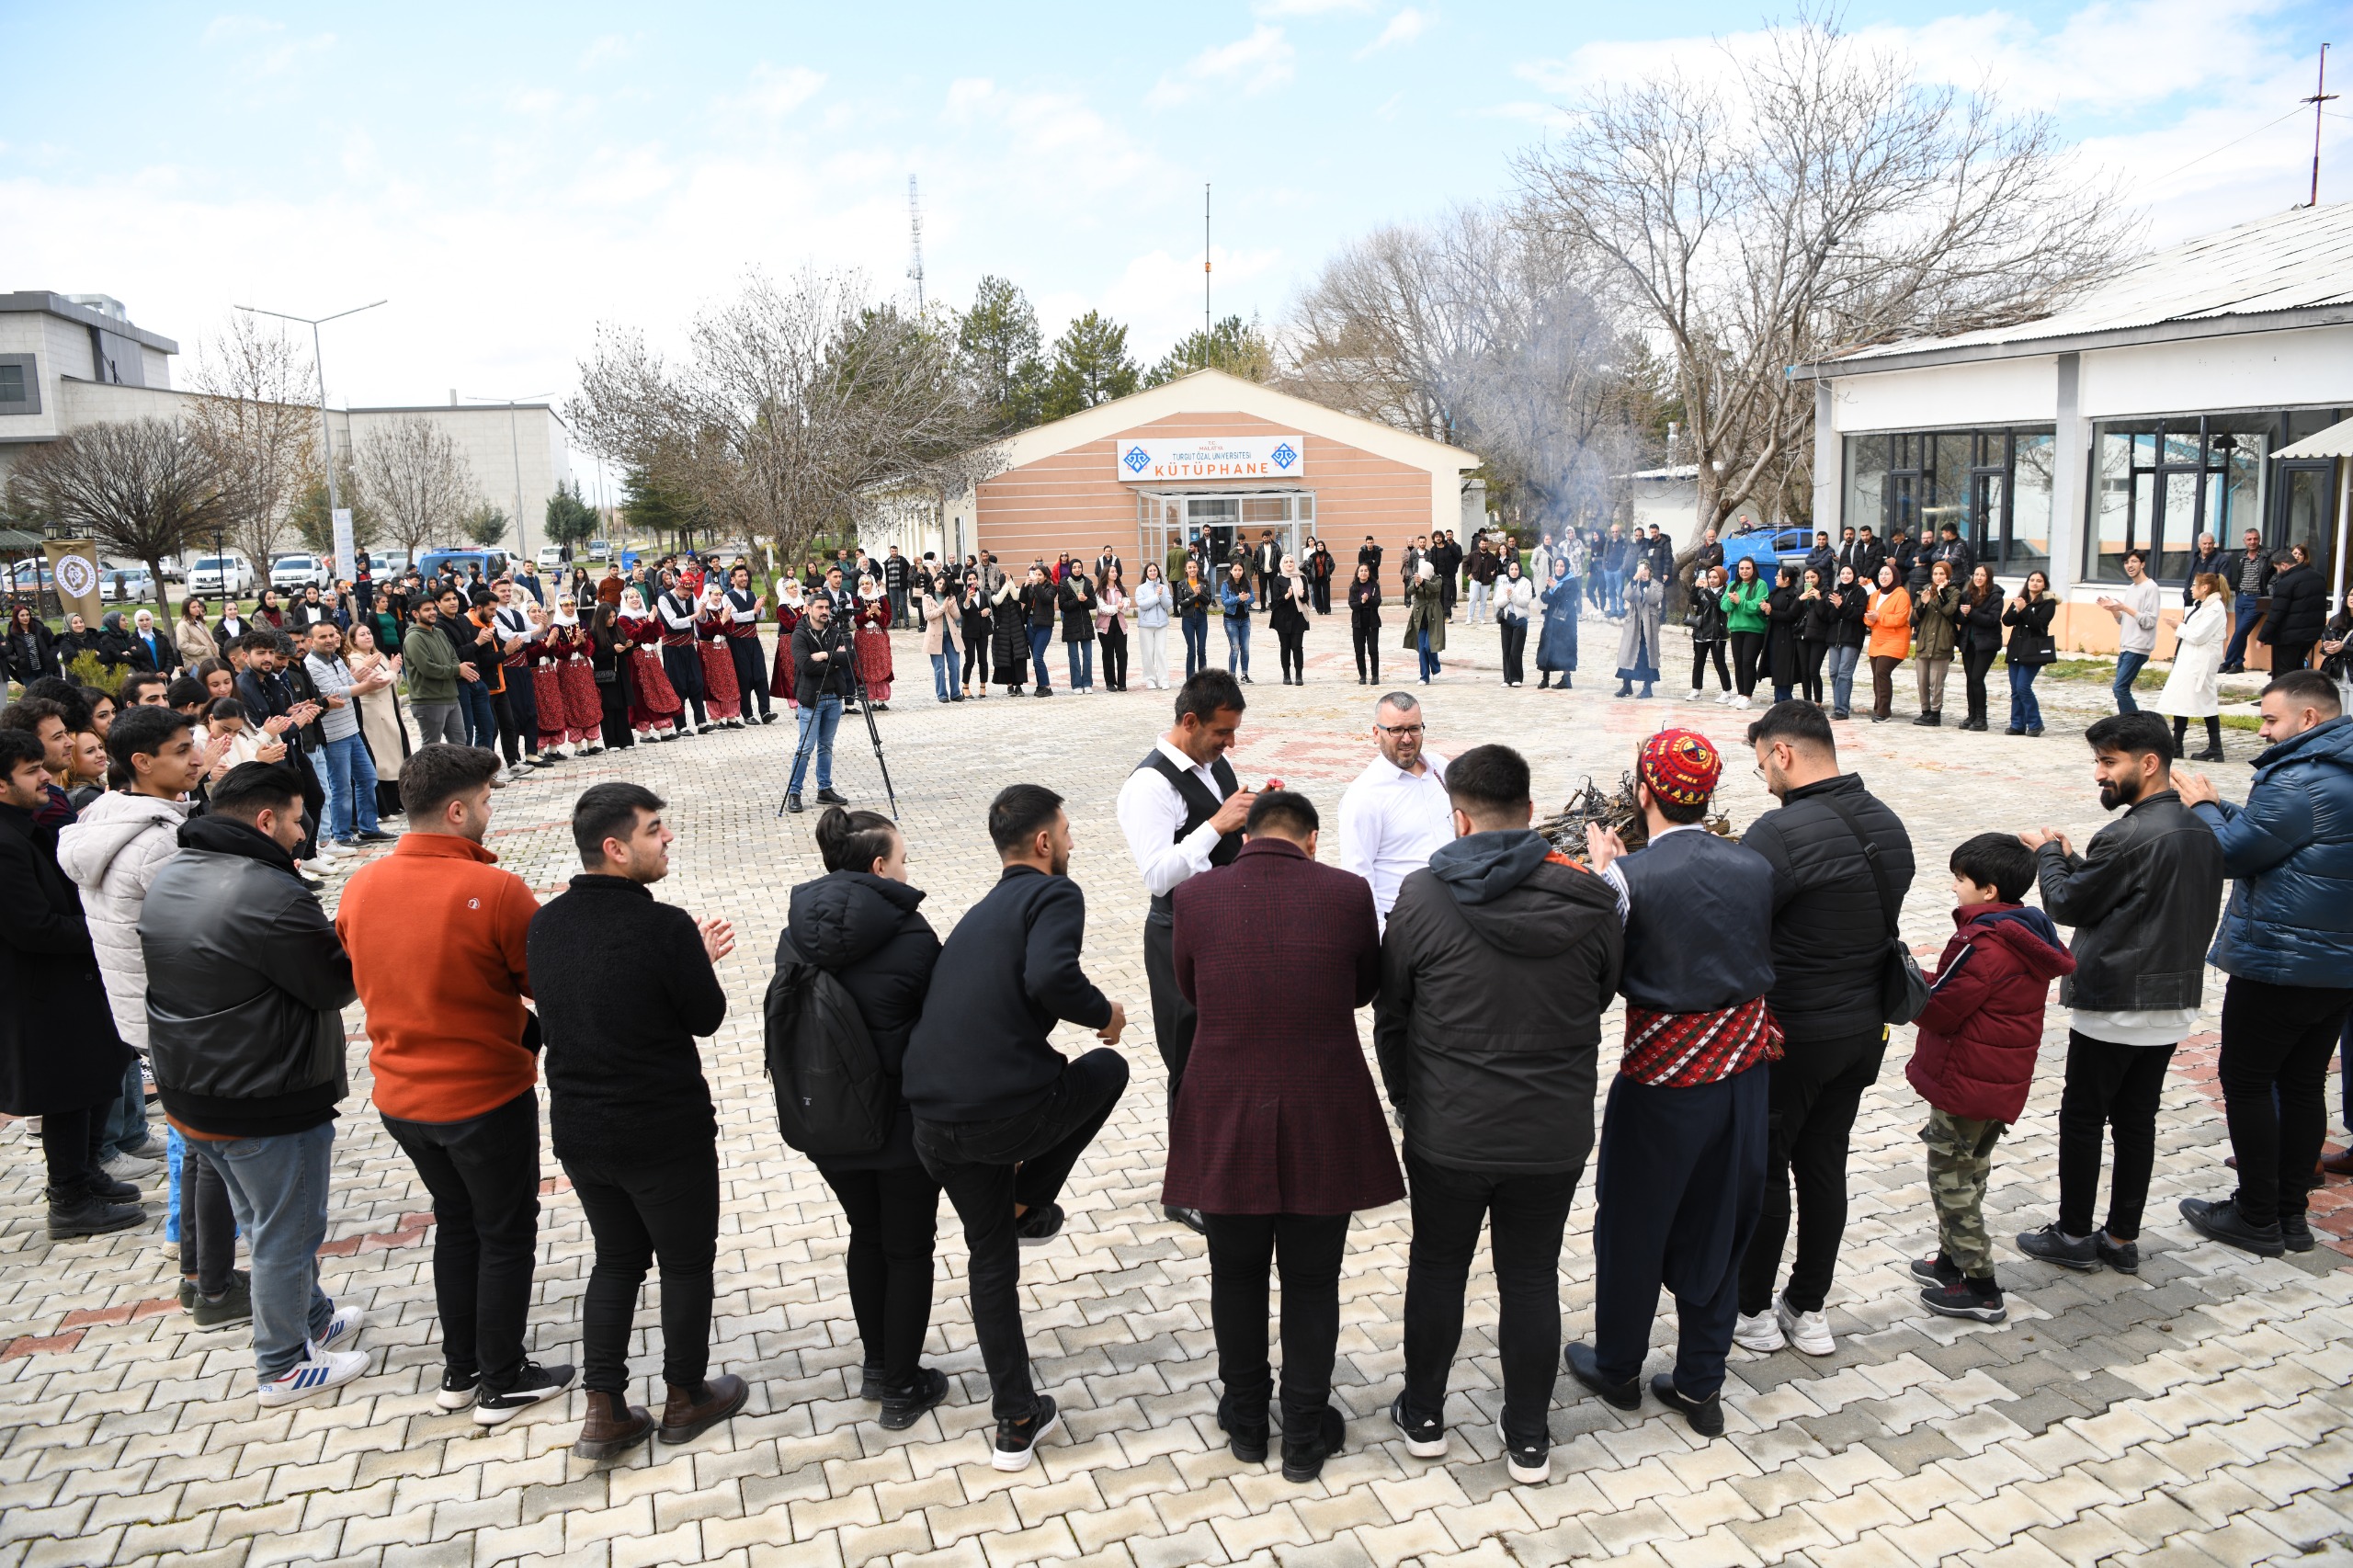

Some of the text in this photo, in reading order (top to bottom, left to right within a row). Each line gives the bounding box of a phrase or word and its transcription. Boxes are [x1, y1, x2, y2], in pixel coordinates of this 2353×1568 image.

[1172, 452, 1196, 460] TURGUT
[1196, 451, 1211, 460] ÖZAL
[1154, 461, 1268, 477] KÜTÜPHANE
